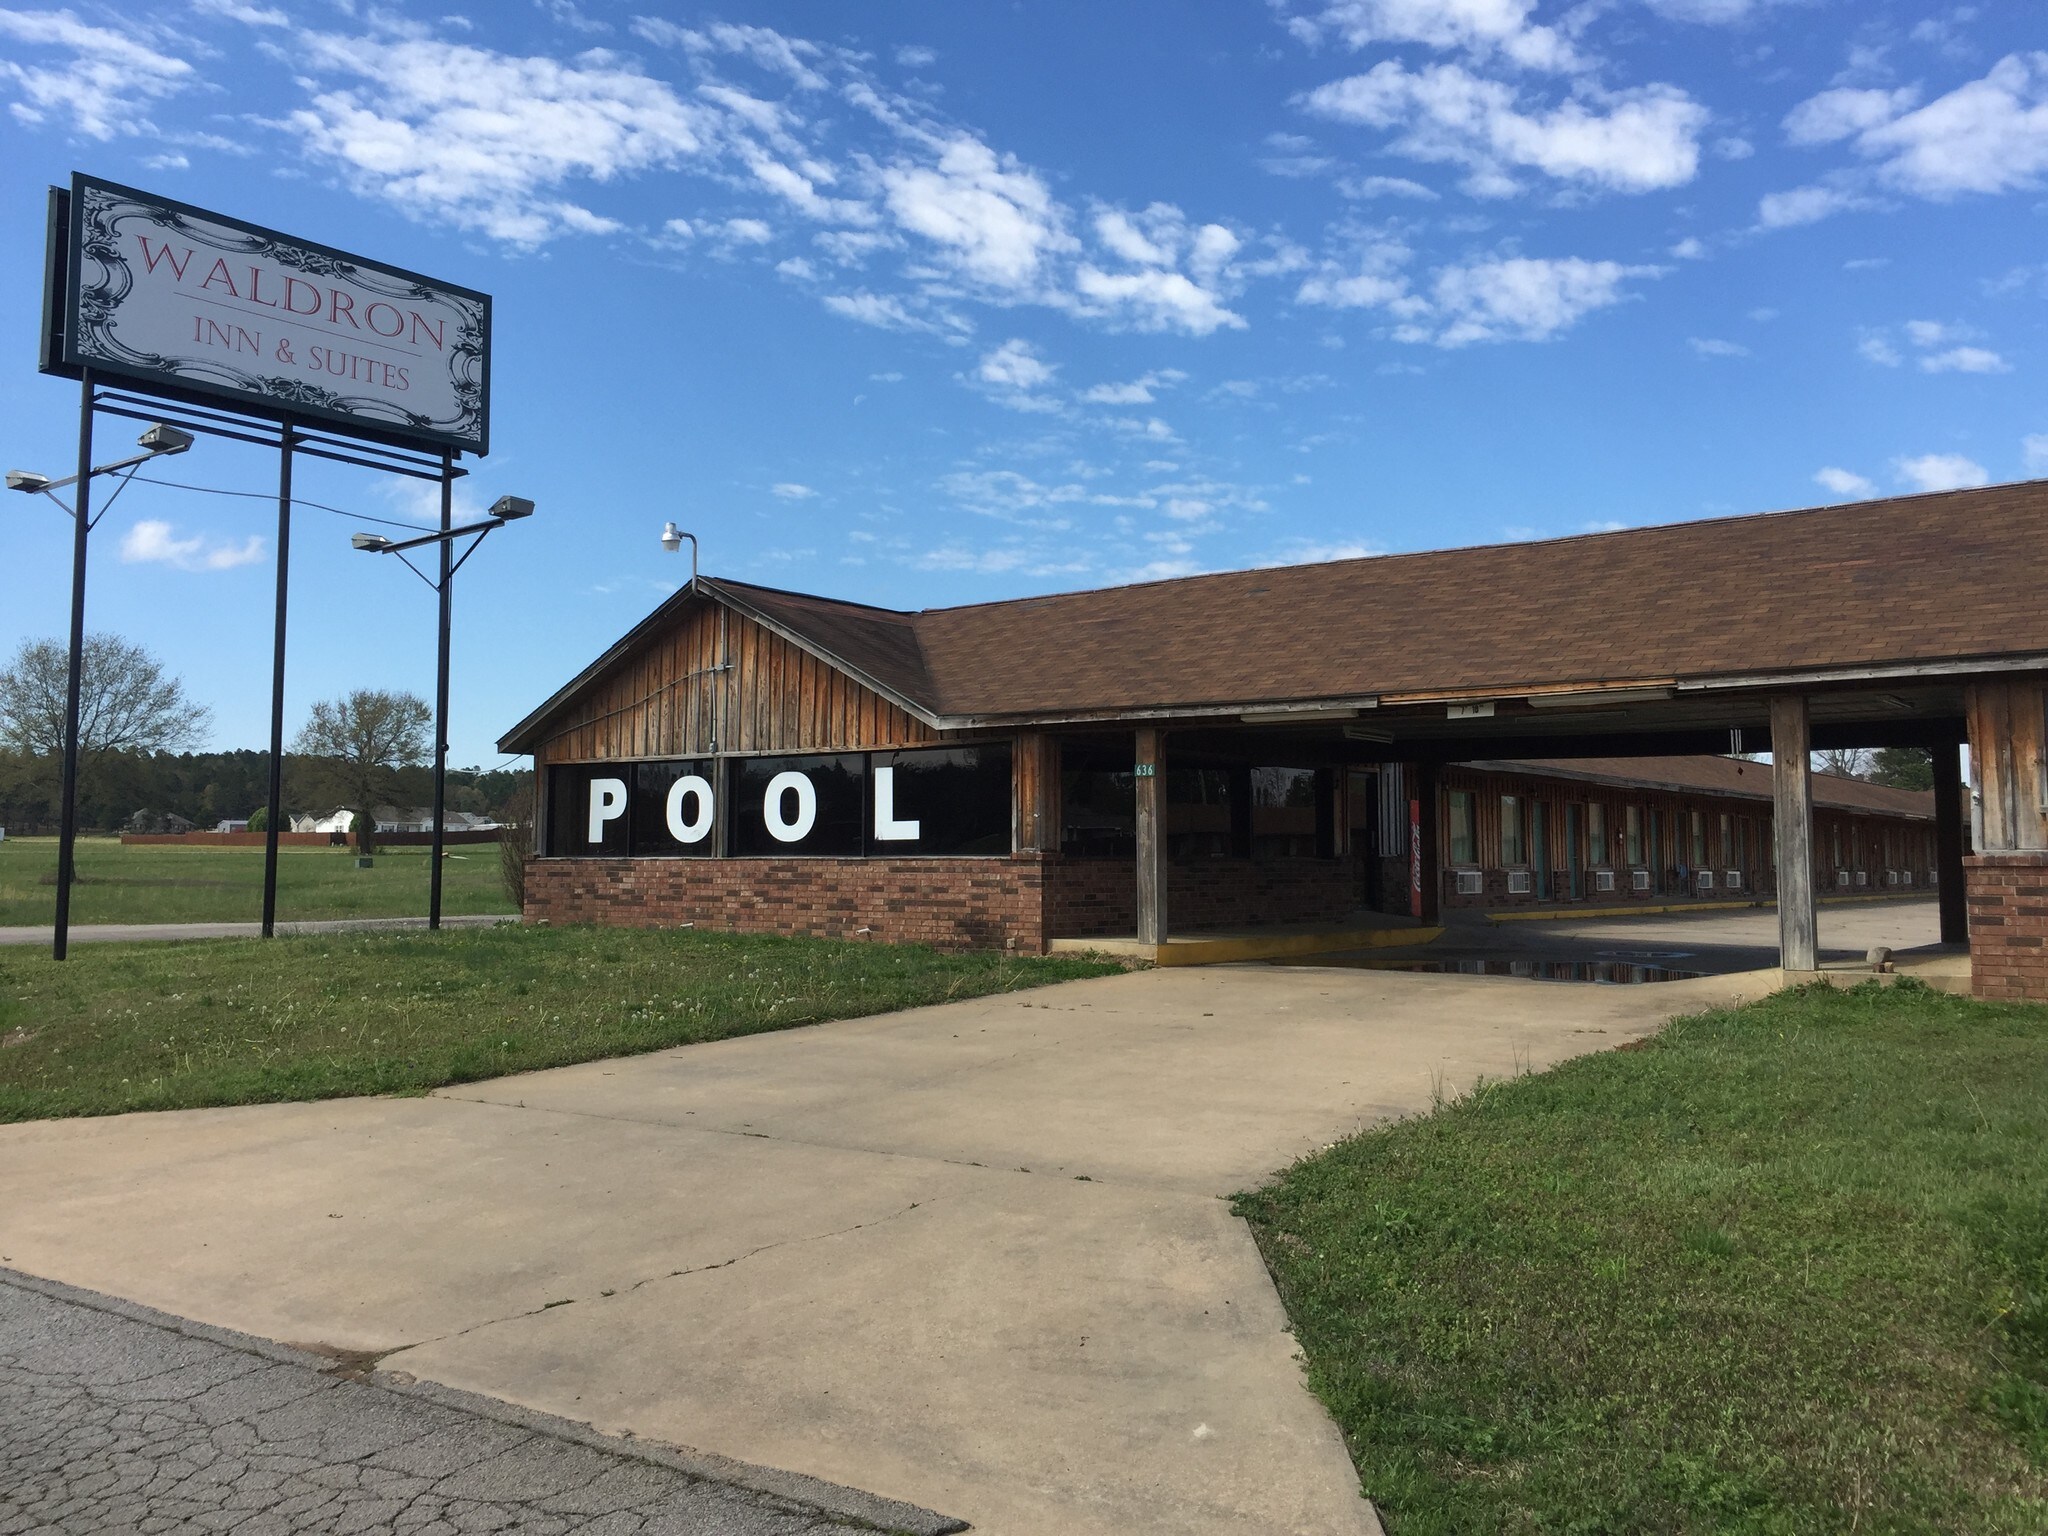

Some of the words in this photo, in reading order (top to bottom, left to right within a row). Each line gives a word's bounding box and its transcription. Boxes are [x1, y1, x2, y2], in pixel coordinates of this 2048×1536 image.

[135, 234, 448, 351] WALDRON
[193, 316, 262, 356] INN
[275, 338, 297, 365] &
[308, 345, 410, 391] SUITES
[588, 767, 920, 844] POOL
[1136, 764, 1153, 776] 636
